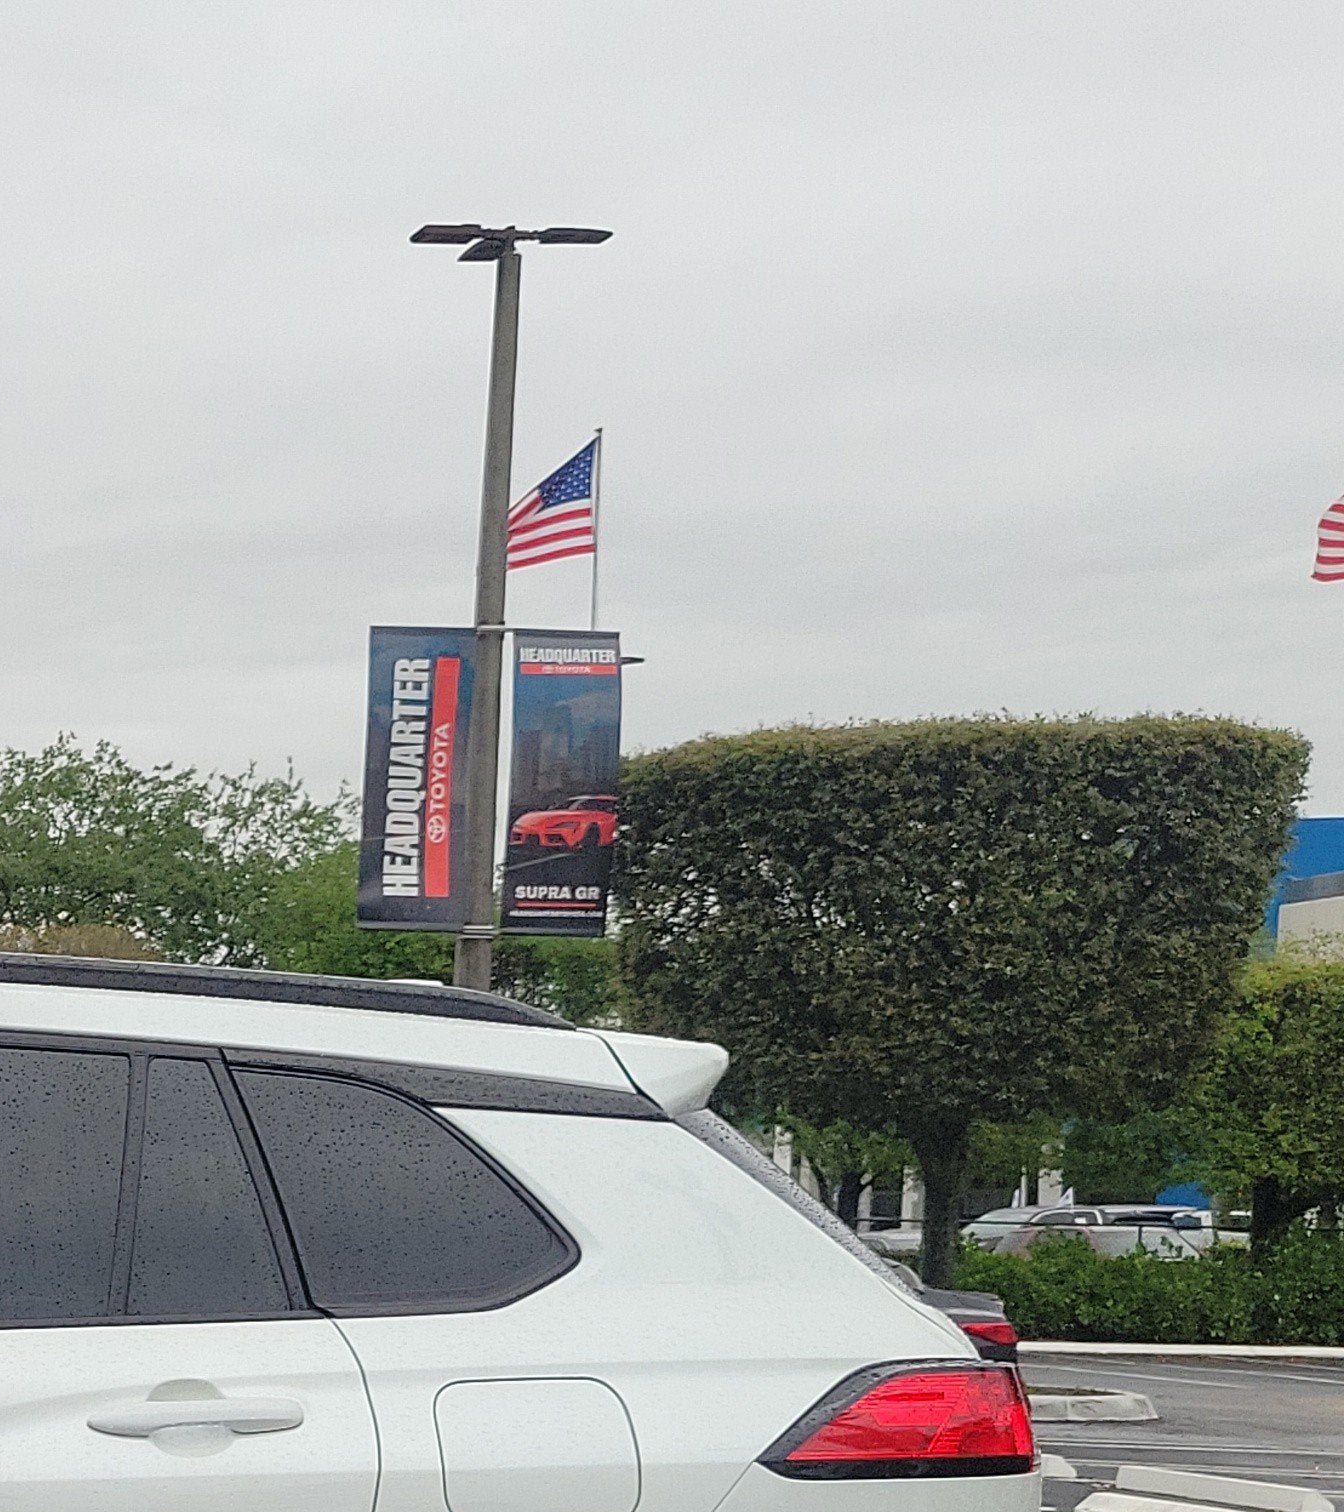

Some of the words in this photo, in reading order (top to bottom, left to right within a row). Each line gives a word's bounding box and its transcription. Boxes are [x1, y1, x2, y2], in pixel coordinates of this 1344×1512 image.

[519, 647, 616, 665] HEADQUARTER
[382, 657, 431, 897] HEADQUARTER
[429, 722, 450, 813] TOYOTA
[515, 885, 571, 899] SUPRA
[574, 885, 601, 900] GR
